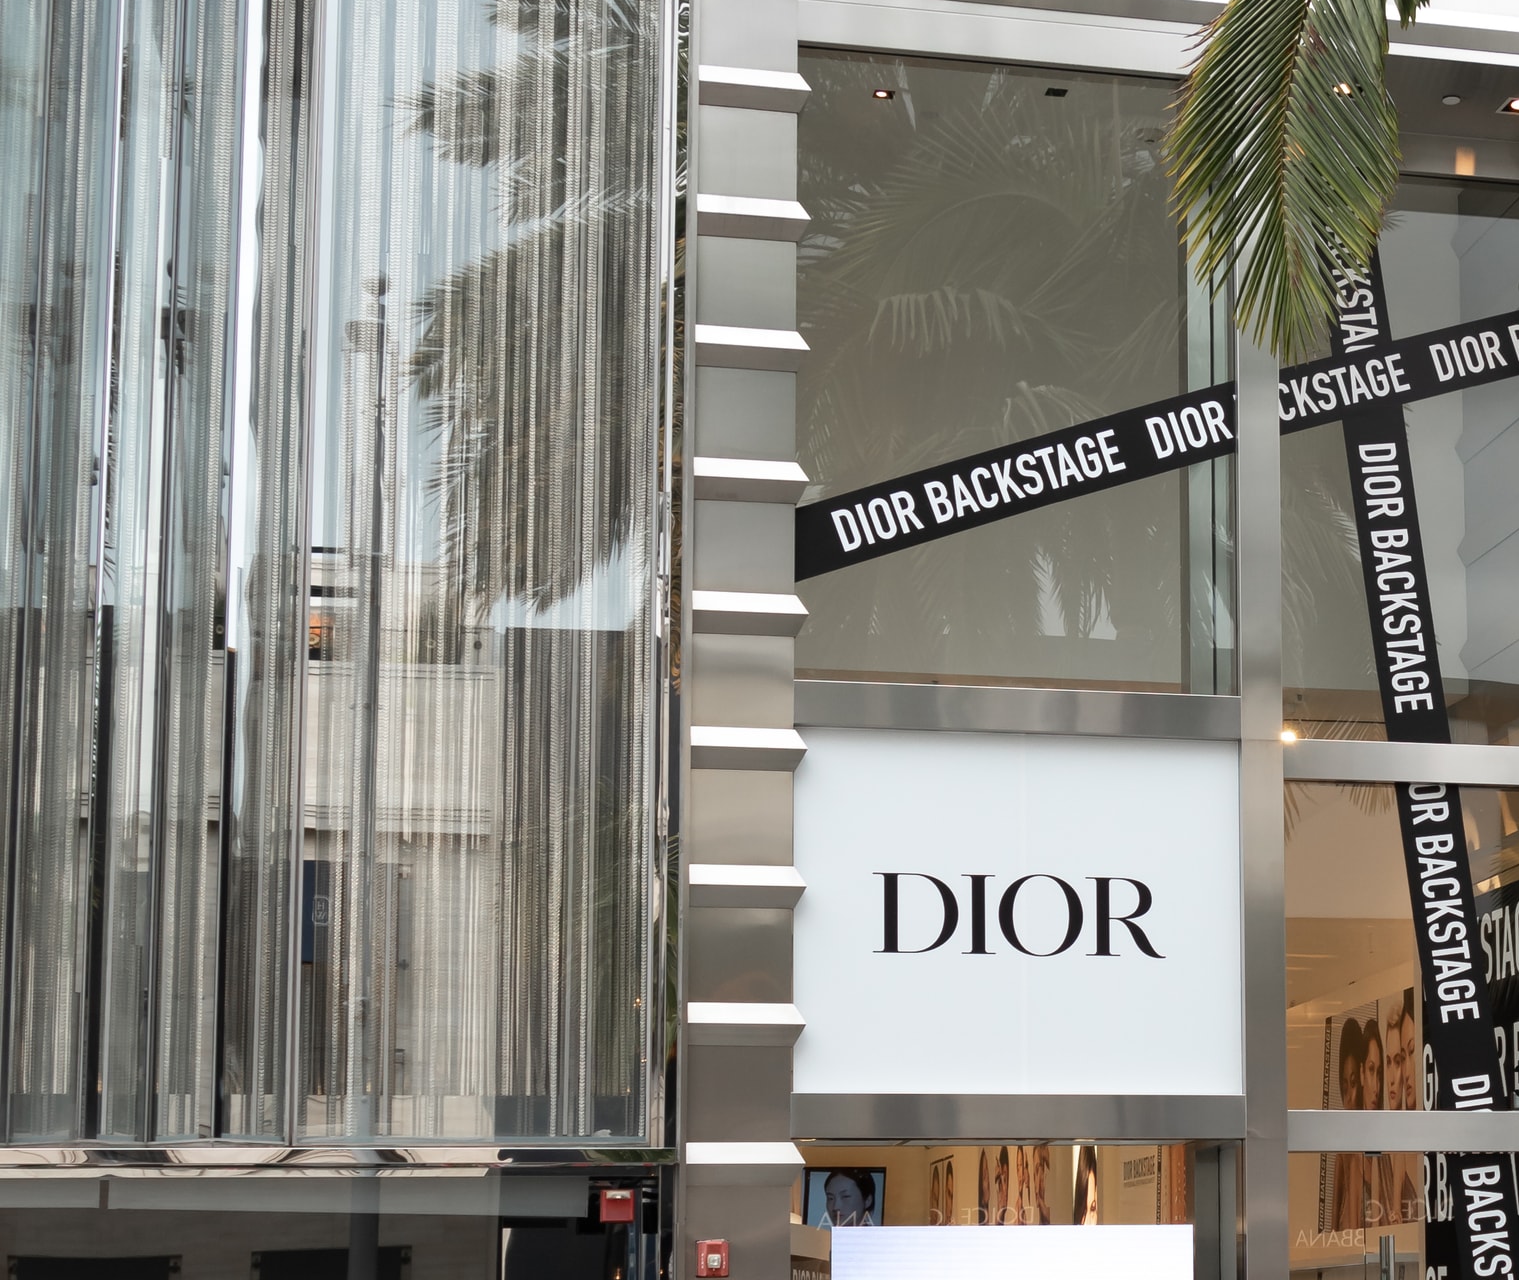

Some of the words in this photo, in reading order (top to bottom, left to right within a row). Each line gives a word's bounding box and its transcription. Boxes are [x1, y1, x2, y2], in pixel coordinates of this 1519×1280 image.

[831, 491, 924, 552] DIOR
[924, 429, 1126, 524] BACKSTAGE
[1145, 400, 1233, 460] DIOR
[1279, 353, 1411, 421] CKSTAGE
[1429, 331, 1508, 382] DIOR
[1358, 442, 1405, 519] DIOR
[1370, 528, 1433, 714] BACKSTAGE
[1407, 784, 1450, 825] OR
[872, 870, 1166, 959] DIOR
[1415, 833, 1480, 1024] BACKSTAGE
[1451, 1074, 1493, 1112] DI
